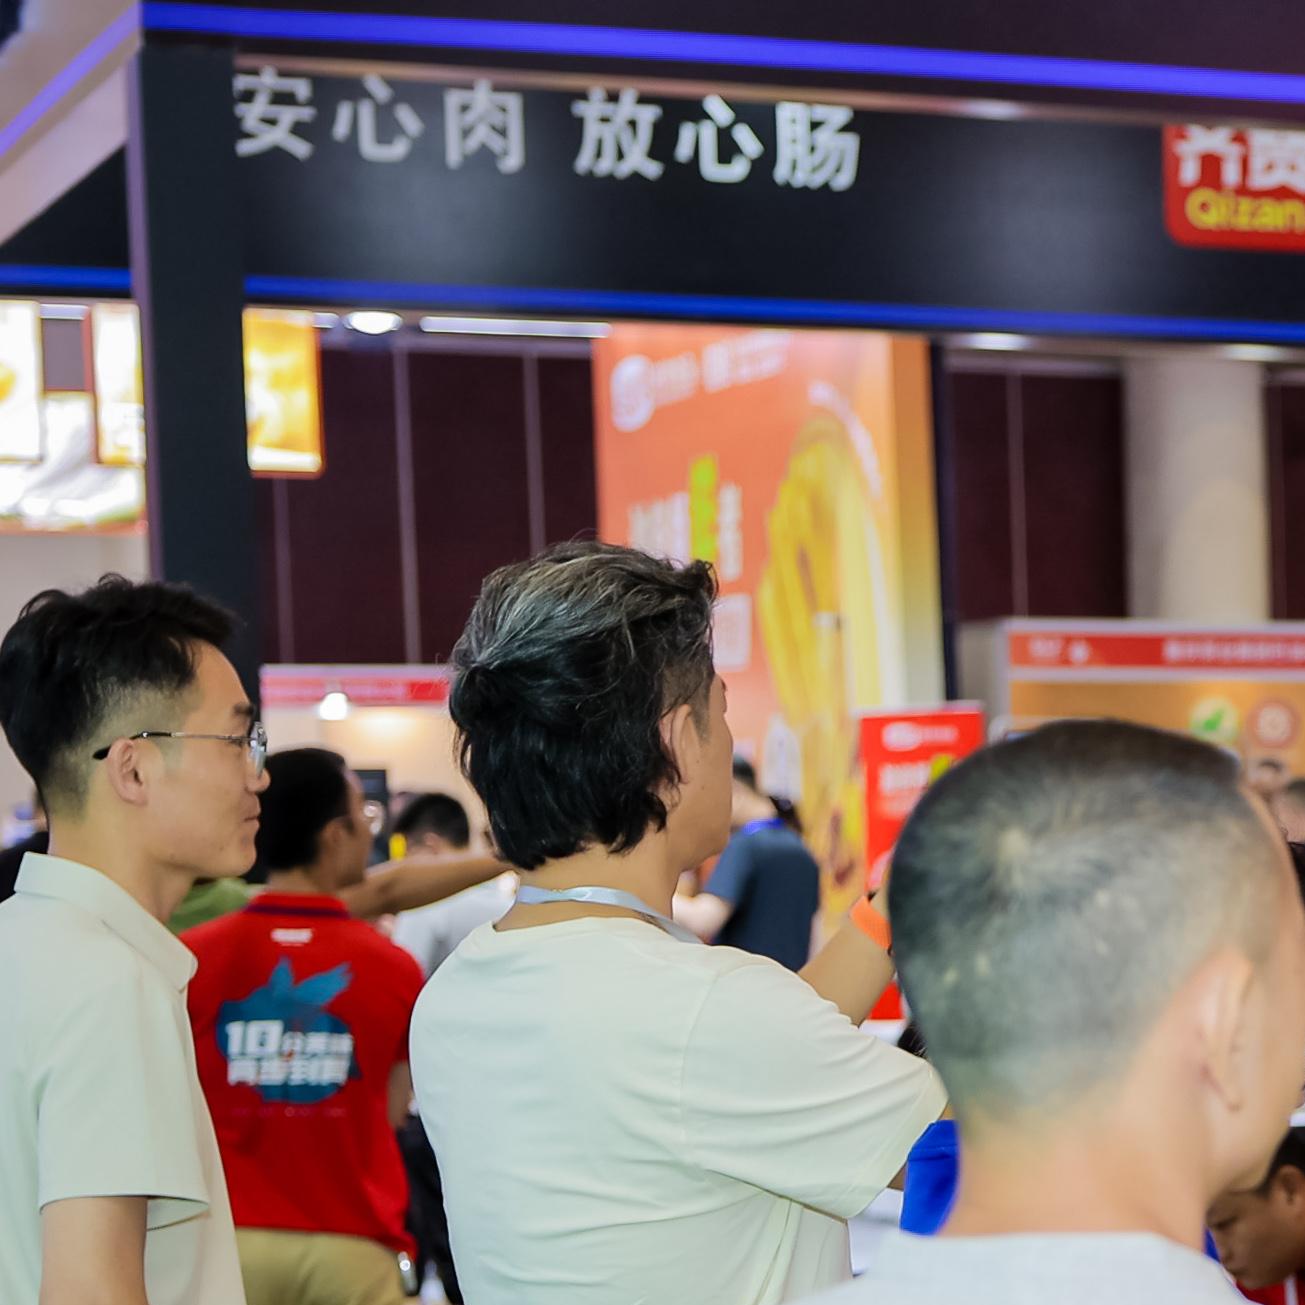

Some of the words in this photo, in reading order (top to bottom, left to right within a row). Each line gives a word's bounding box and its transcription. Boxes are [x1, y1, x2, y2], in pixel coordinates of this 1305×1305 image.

[233, 67, 526, 174] 安心肉
[571, 87, 861, 192] 放心肠
